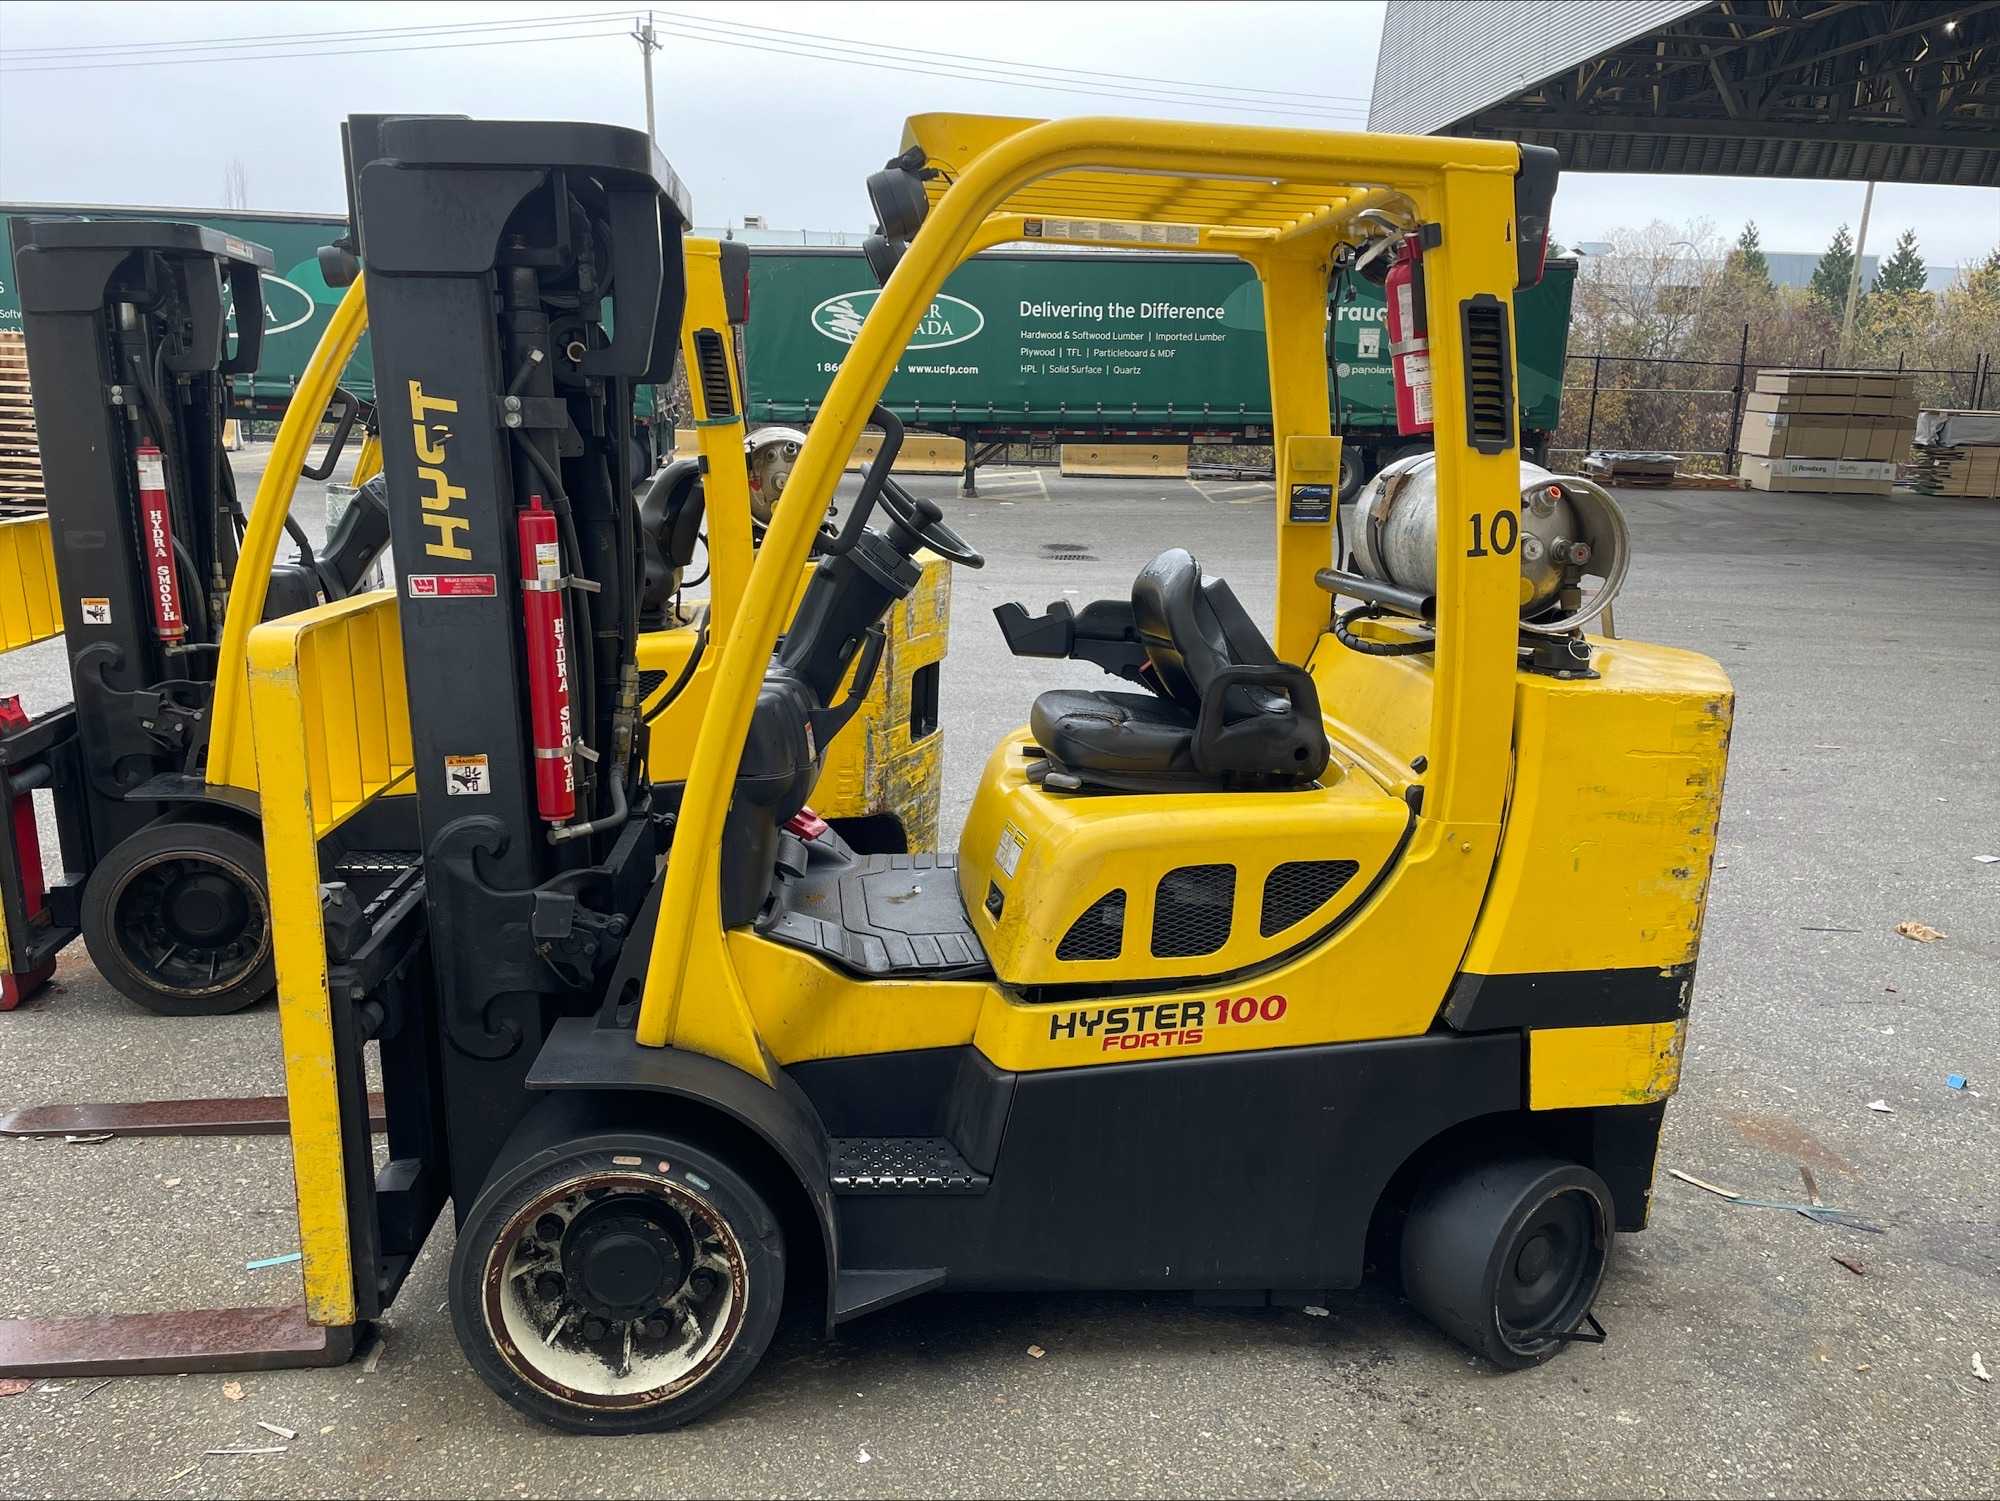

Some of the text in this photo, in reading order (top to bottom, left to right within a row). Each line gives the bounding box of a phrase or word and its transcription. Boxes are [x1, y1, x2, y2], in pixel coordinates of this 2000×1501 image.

[1019, 301, 1225, 322] Delivering the Difference
[914, 321, 955, 336] ADA
[1020, 330, 1226, 342] Hardwood & Softwood Lumber Imported Lumber
[1020, 347, 1176, 358] Plywood TFL Particleboard & MDF
[908, 364, 979, 375] www.ucfp.com
[1020, 365, 1142, 375] HPL Solid Surface Quartz
[149, 510, 168, 558] HYDRA
[1466, 510, 1518, 558] 10
[157, 565, 176, 621] SMOOTH
[553, 617, 569, 691] HYDRA
[1050, 995, 1288, 1041] HYSTER 100
[1102, 1028, 1204, 1052] FORTIS
